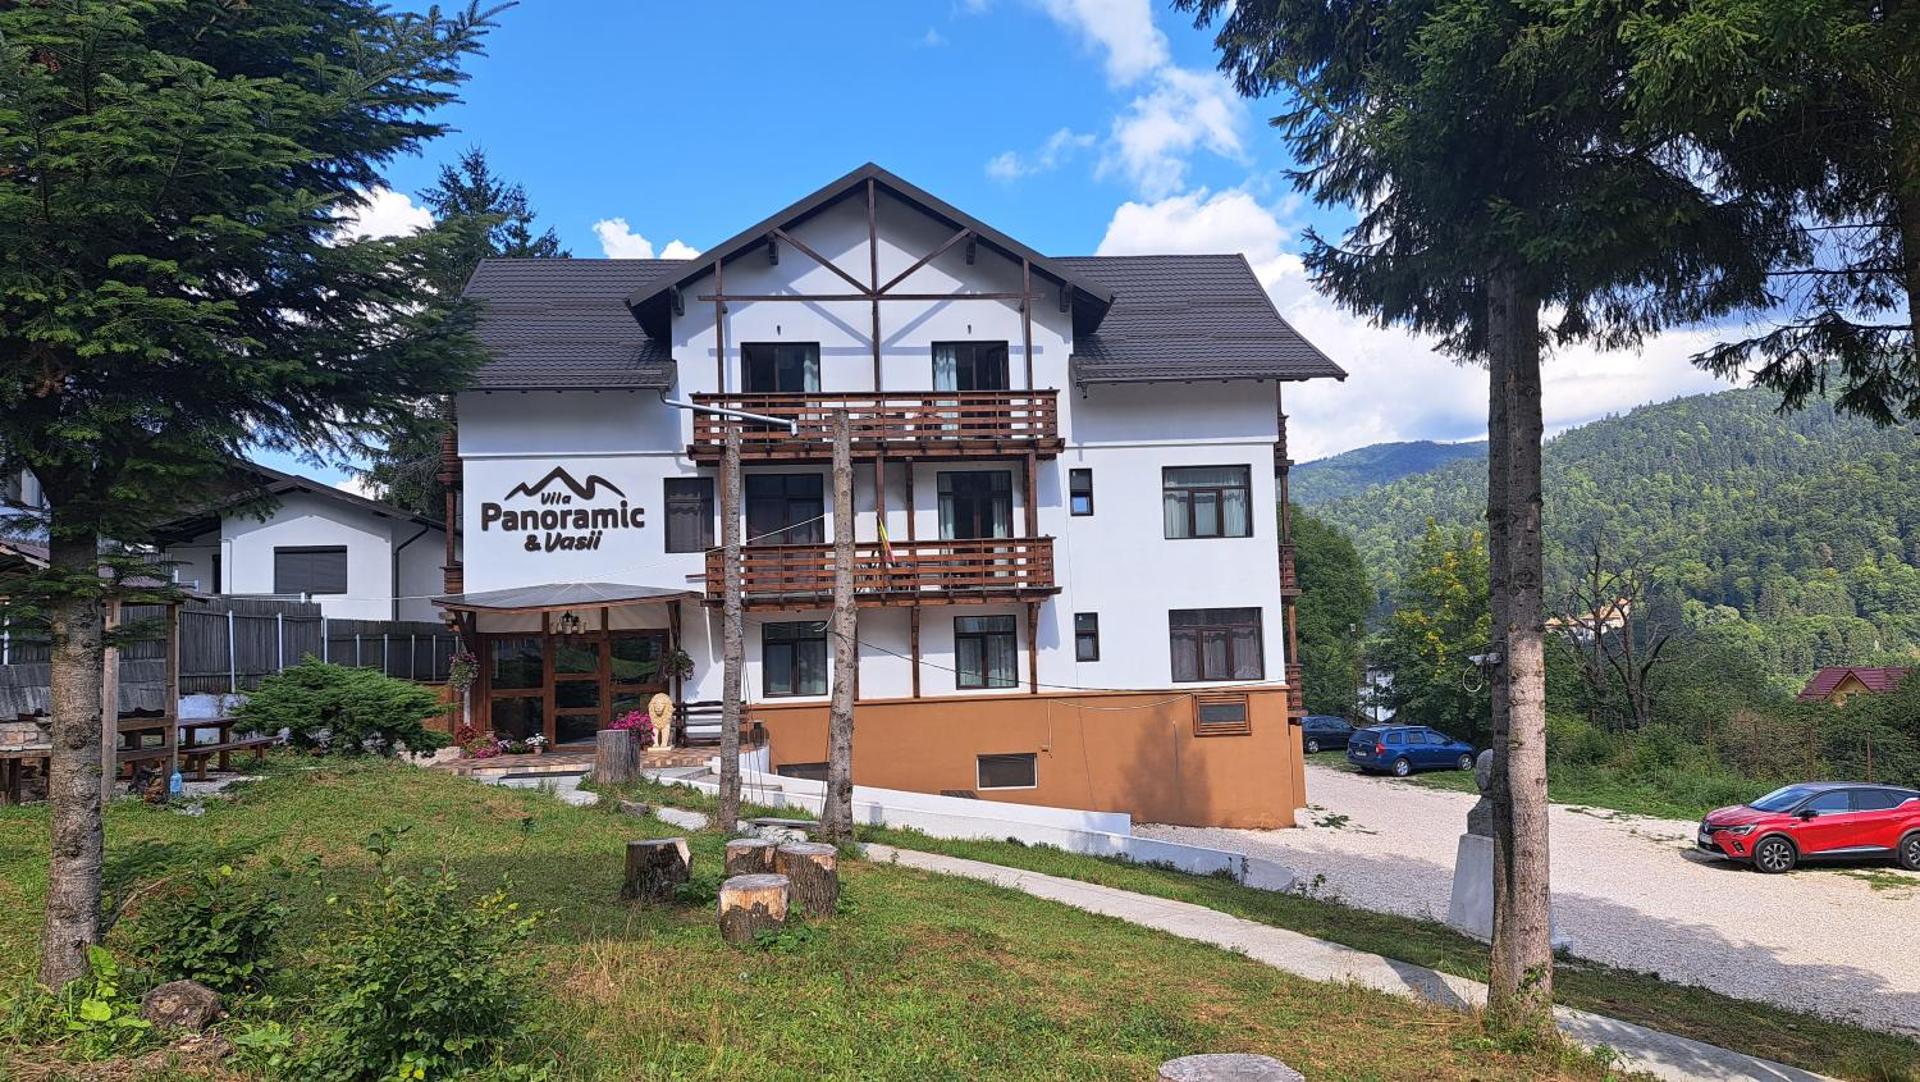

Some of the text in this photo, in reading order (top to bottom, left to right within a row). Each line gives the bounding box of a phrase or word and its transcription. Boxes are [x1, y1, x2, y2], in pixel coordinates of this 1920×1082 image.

[541, 491, 571, 505] Vila
[481, 500, 645, 532] Panoramic
[524, 530, 603, 553] & Vasii
